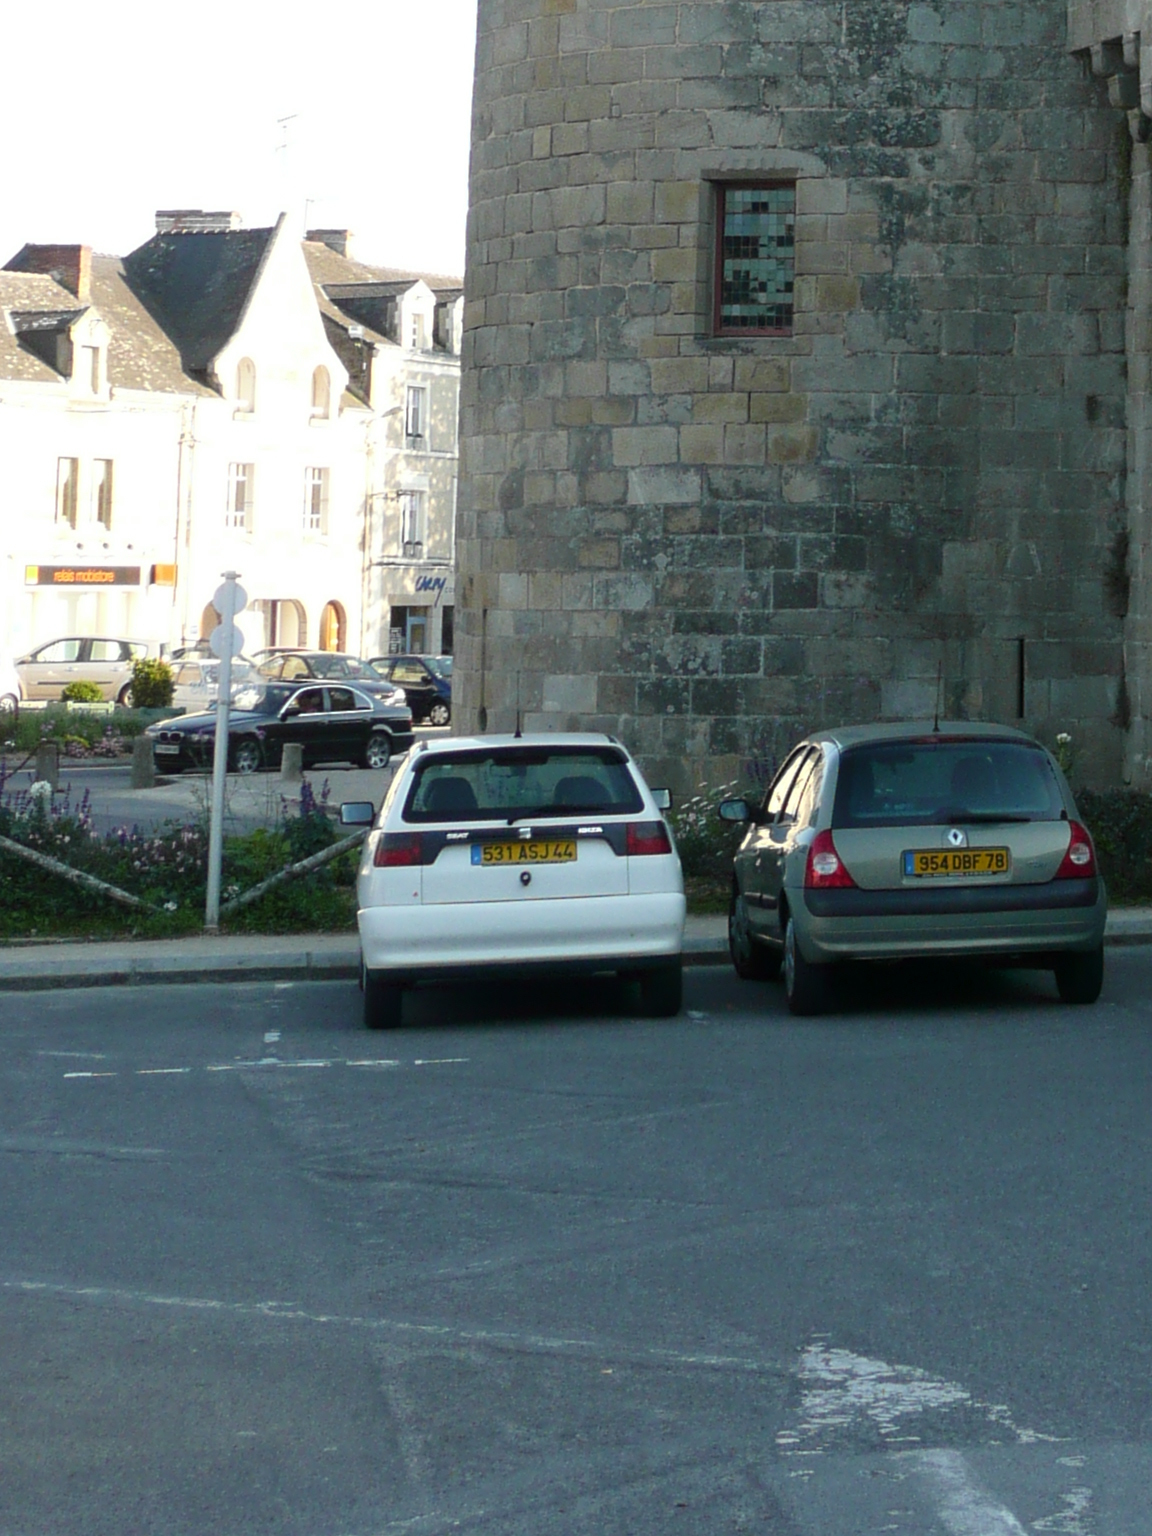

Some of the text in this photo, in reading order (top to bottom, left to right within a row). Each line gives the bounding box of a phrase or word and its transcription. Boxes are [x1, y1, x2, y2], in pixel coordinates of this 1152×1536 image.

[483, 843, 573, 862] 531 ASJ 44
[919, 853, 1005, 872] 954 DBF 78
